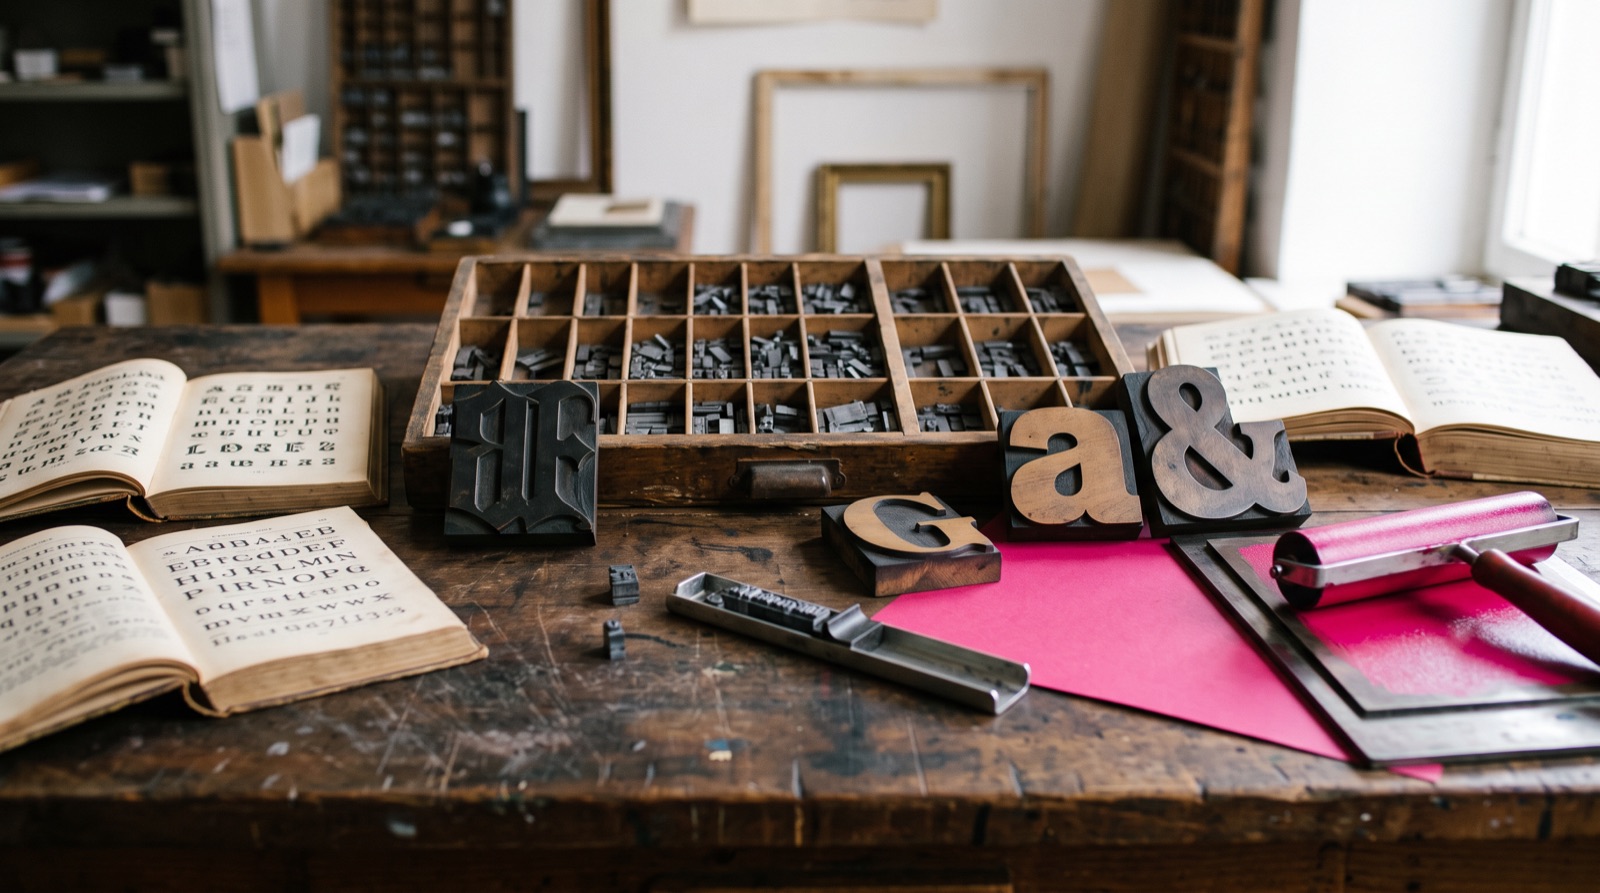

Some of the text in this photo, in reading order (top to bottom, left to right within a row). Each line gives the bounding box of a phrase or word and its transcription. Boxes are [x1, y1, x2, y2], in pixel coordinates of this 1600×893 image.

[1009, 406, 1142, 525] a
[1147, 365, 1307, 519] &
[843, 491, 994, 554] G
